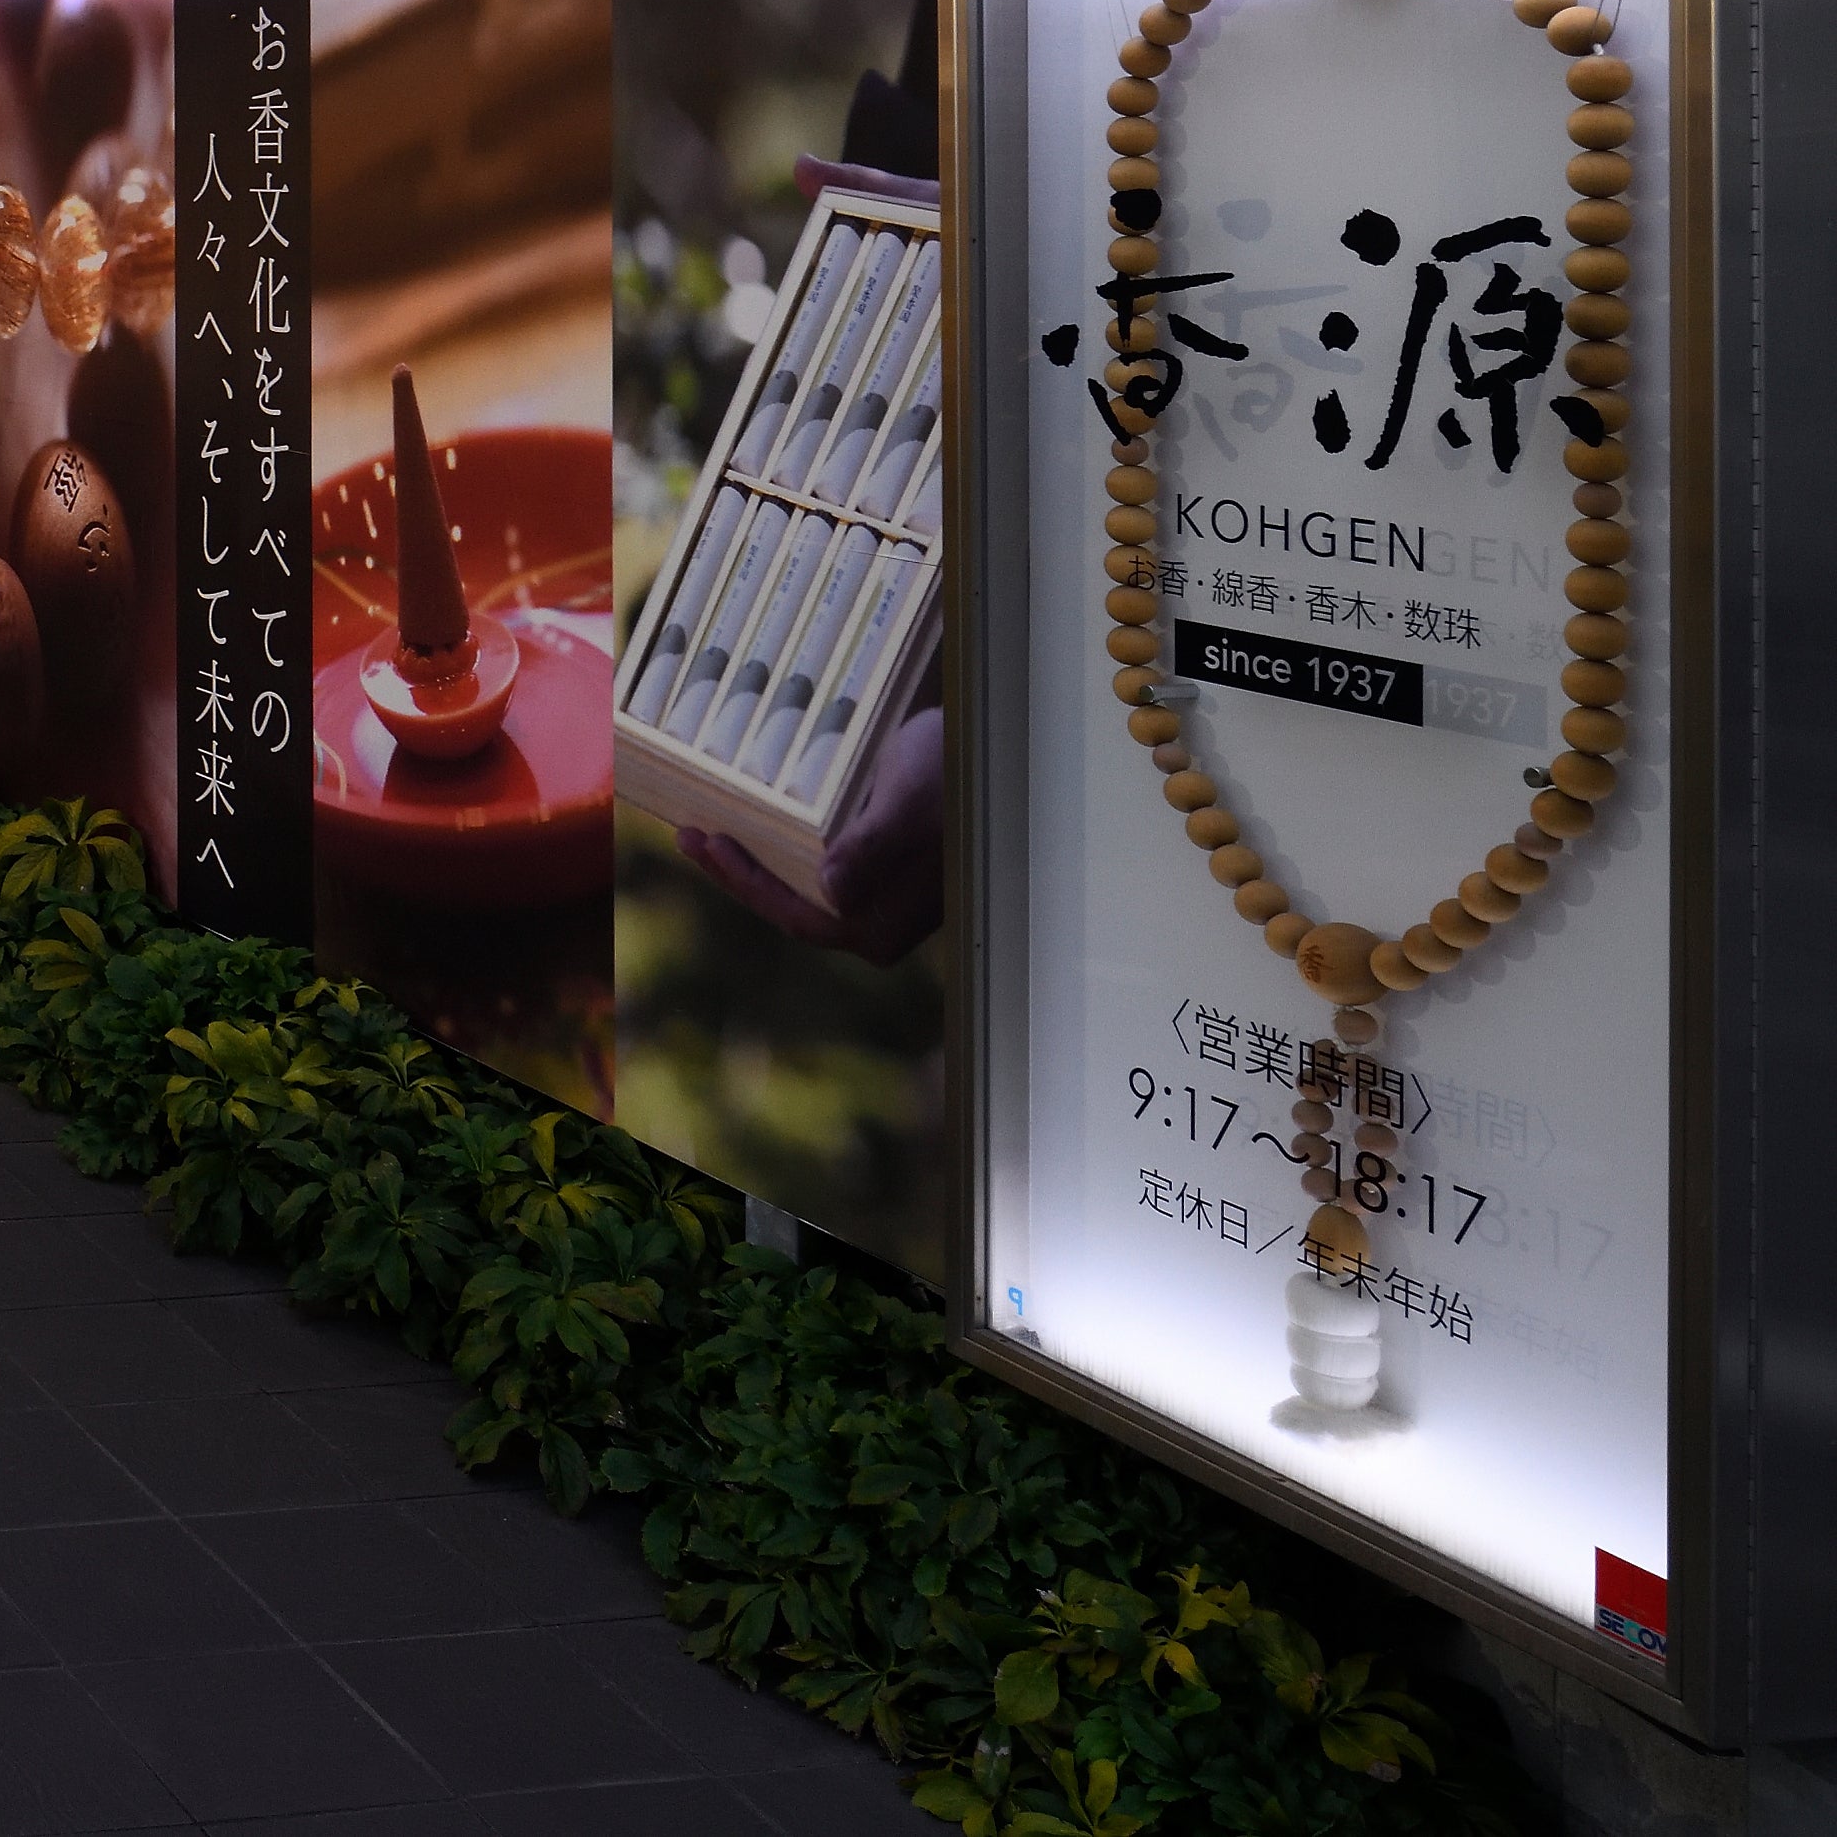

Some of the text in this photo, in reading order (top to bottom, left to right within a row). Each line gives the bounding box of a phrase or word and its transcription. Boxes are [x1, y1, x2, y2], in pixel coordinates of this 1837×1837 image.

[247, 6, 291, 754] お香文化をすべての
[1041, 188, 1606, 474] 香源
[192, 132, 236, 890] 人々へ、そして未来へ
[1176, 493, 1427, 572] KOHGEN
[1125, 556, 1482, 650] お香・線香・香木・数珠
[1203, 638, 1397, 706] since 1937
[1172, 998, 1433, 1135] 〈営業時間〉
[1138, 1167, 1474, 1345] 定休日／年末年始
